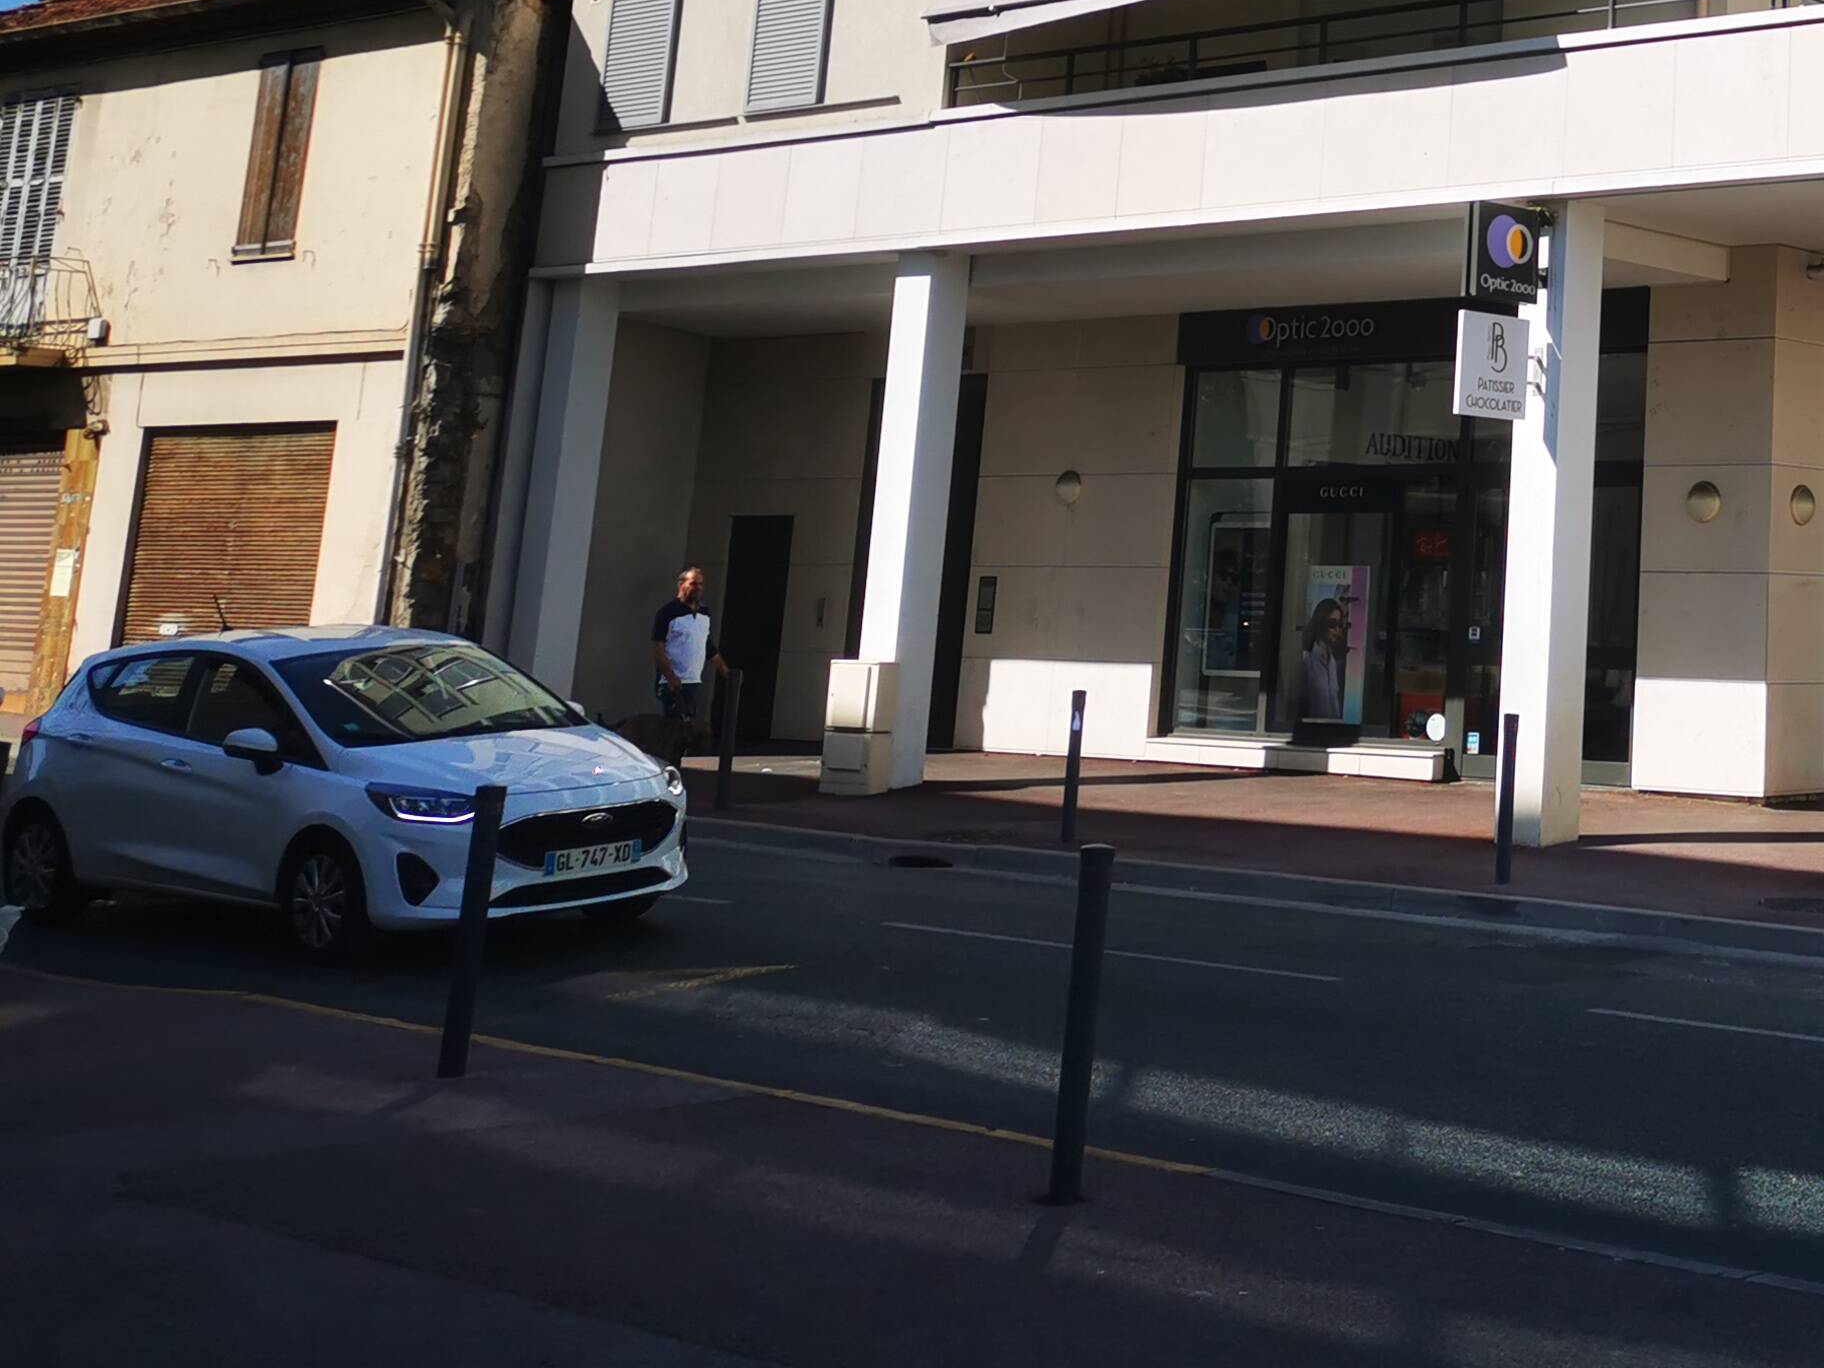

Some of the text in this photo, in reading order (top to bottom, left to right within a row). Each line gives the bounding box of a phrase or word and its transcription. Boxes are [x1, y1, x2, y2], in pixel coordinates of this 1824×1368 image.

[1465, 394, 1522, 412] CHOCOLATIER
[1319, 486, 1364, 498] GUCCI
[556, 843, 631, 872] GL-747-XD
